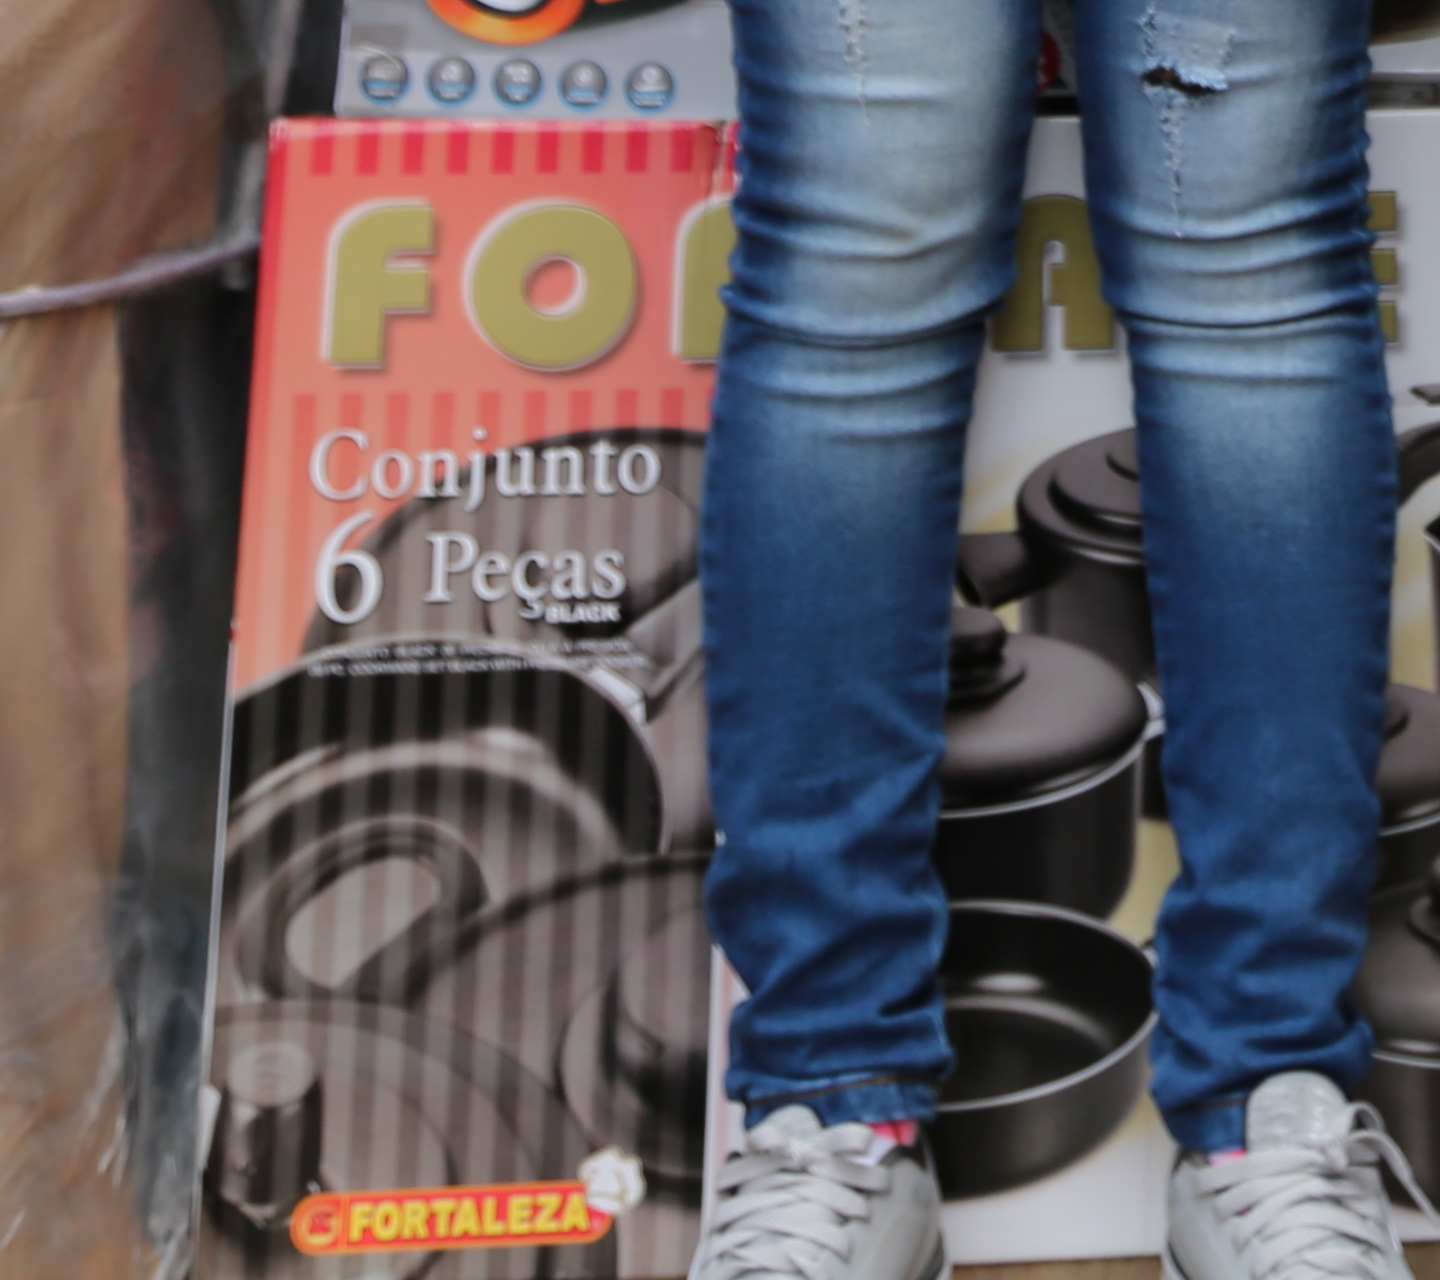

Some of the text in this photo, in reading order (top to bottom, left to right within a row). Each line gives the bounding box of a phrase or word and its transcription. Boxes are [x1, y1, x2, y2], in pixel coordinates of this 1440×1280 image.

[307, 426, 662, 513] Conjunto
[313, 510, 628, 626] 6 Peças
[544, 602, 622, 625] BLACK
[347, 1192, 591, 1243] FORTALEZA
